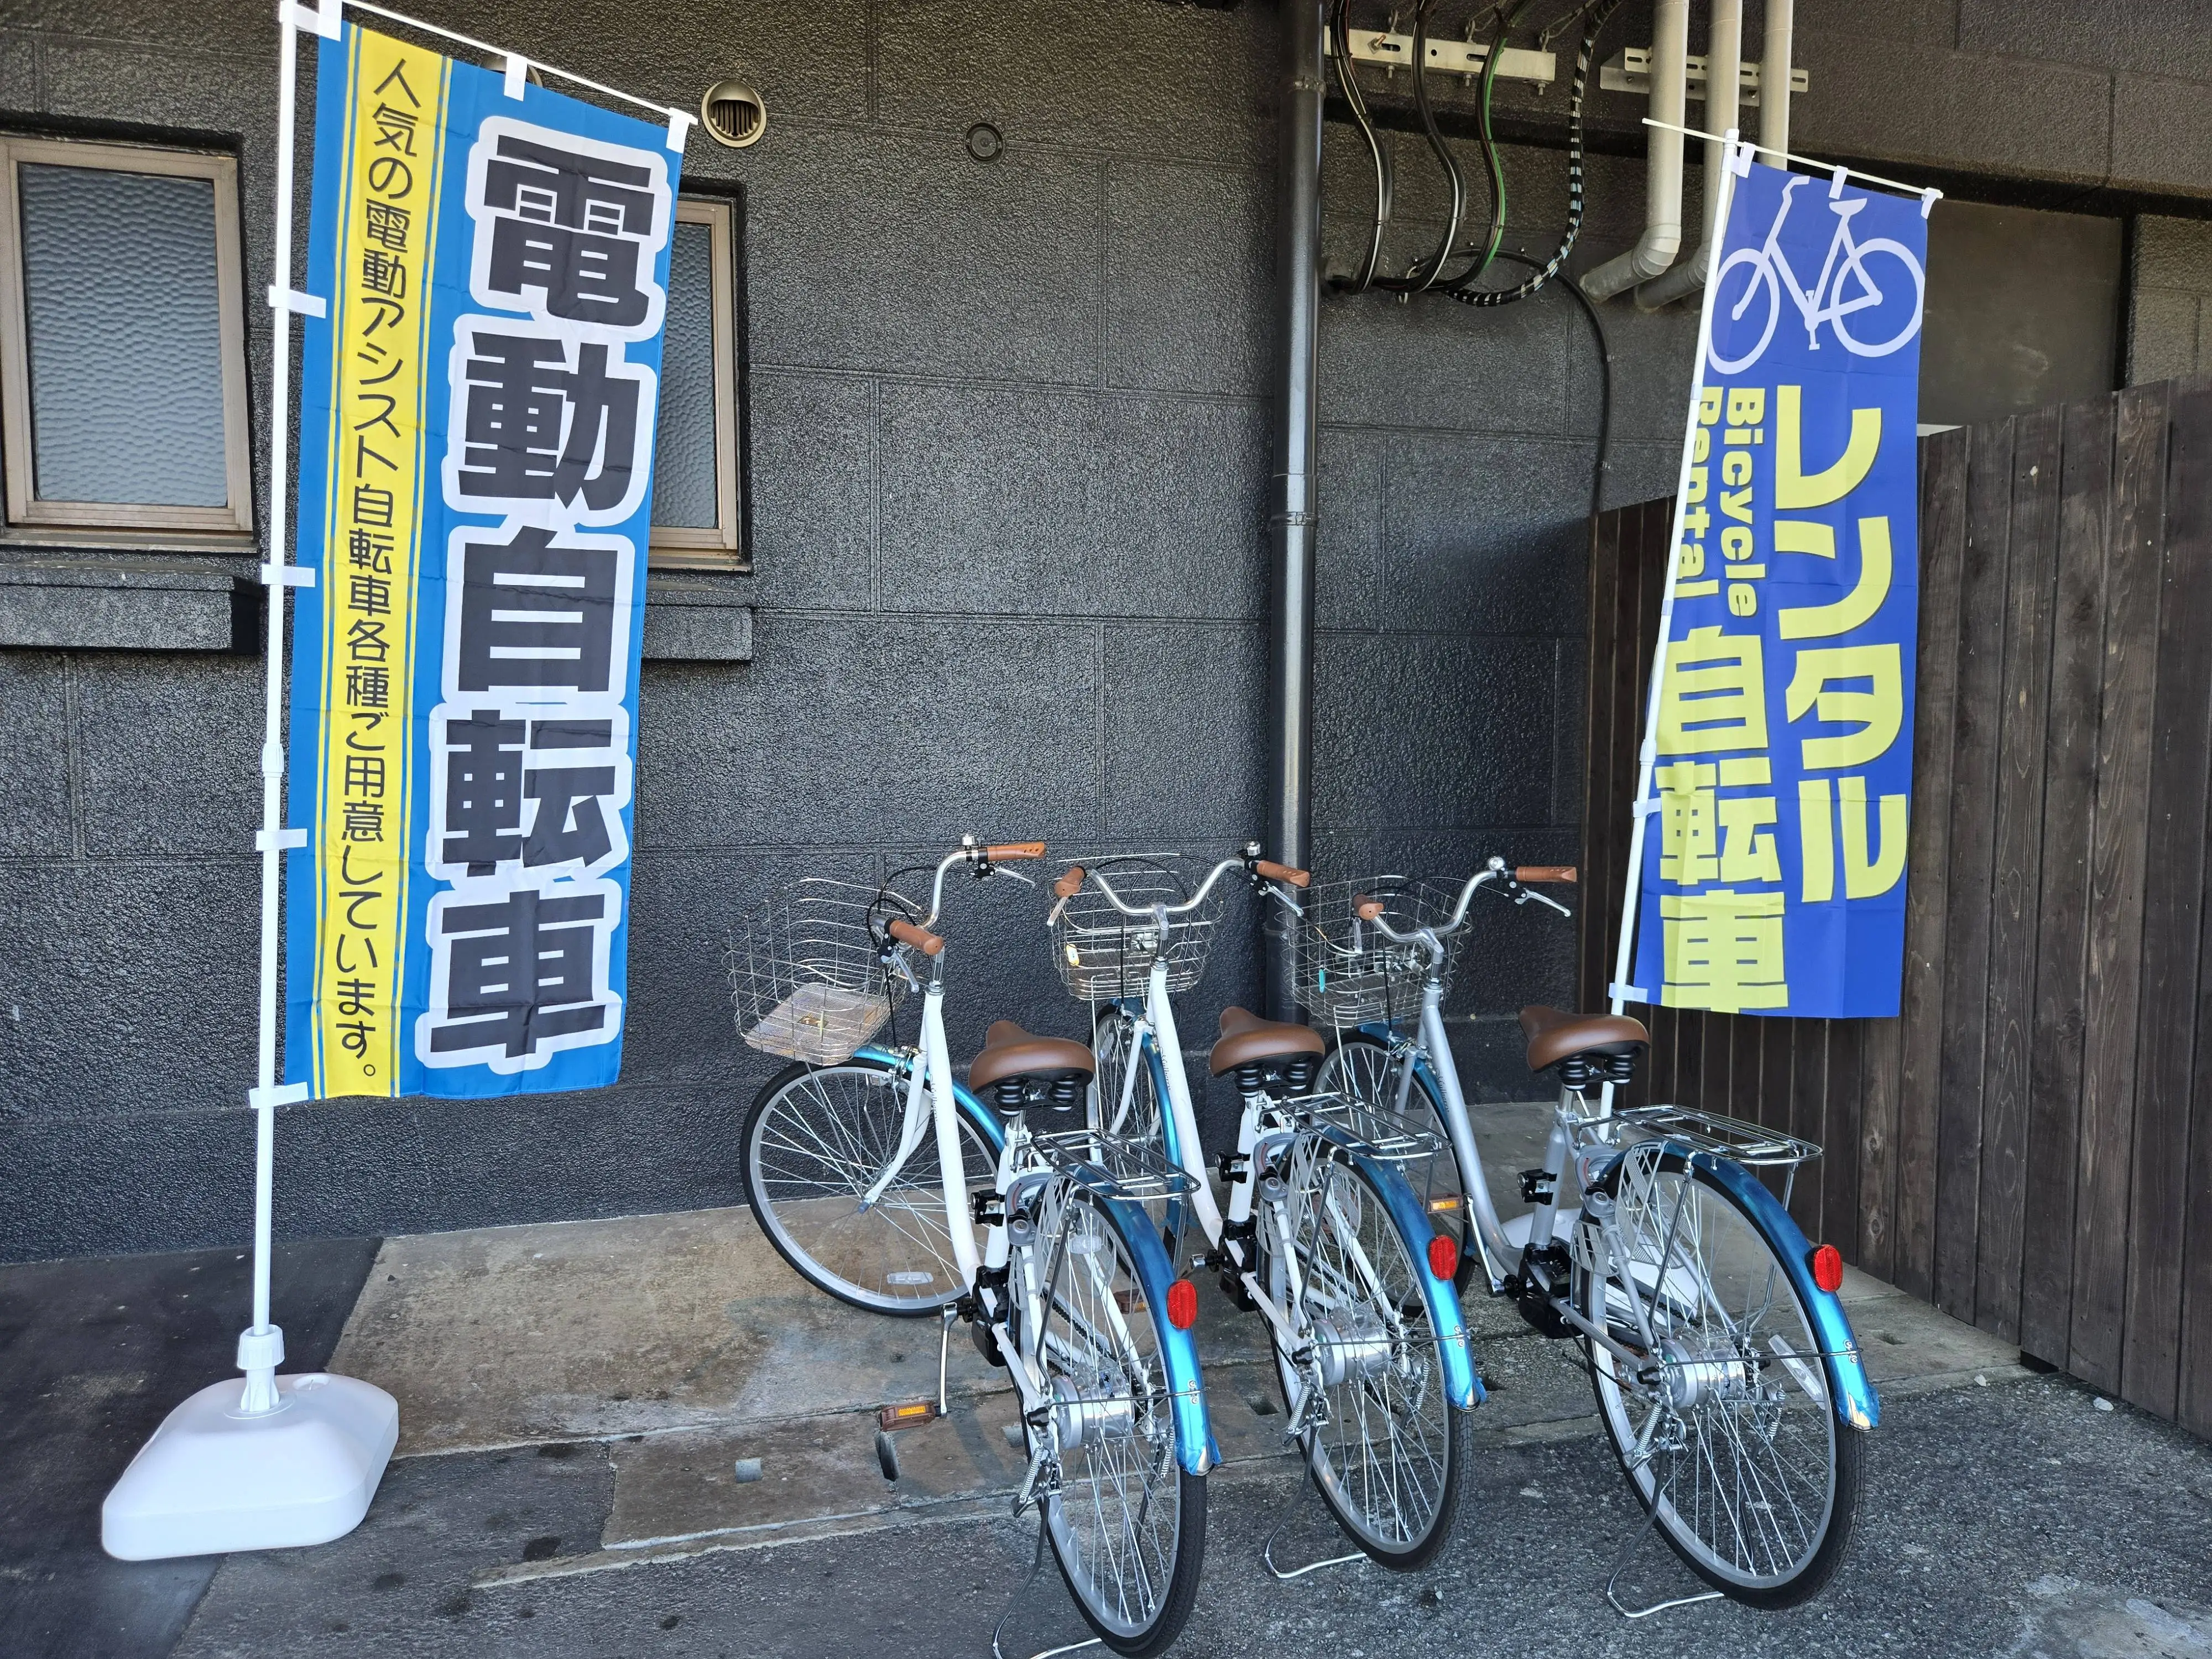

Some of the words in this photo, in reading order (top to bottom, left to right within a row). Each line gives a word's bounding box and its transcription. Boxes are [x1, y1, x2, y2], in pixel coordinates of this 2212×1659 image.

[335, 58, 422, 1078] 人気の電動アシスト自転車各種ご用意しています。
[430, 134, 655, 1058] 電動自転車
[1720, 388, 1766, 618] Bicycle
[1773, 385, 1907, 903] レンタル
[1655, 625, 1789, 1014] 自転車
